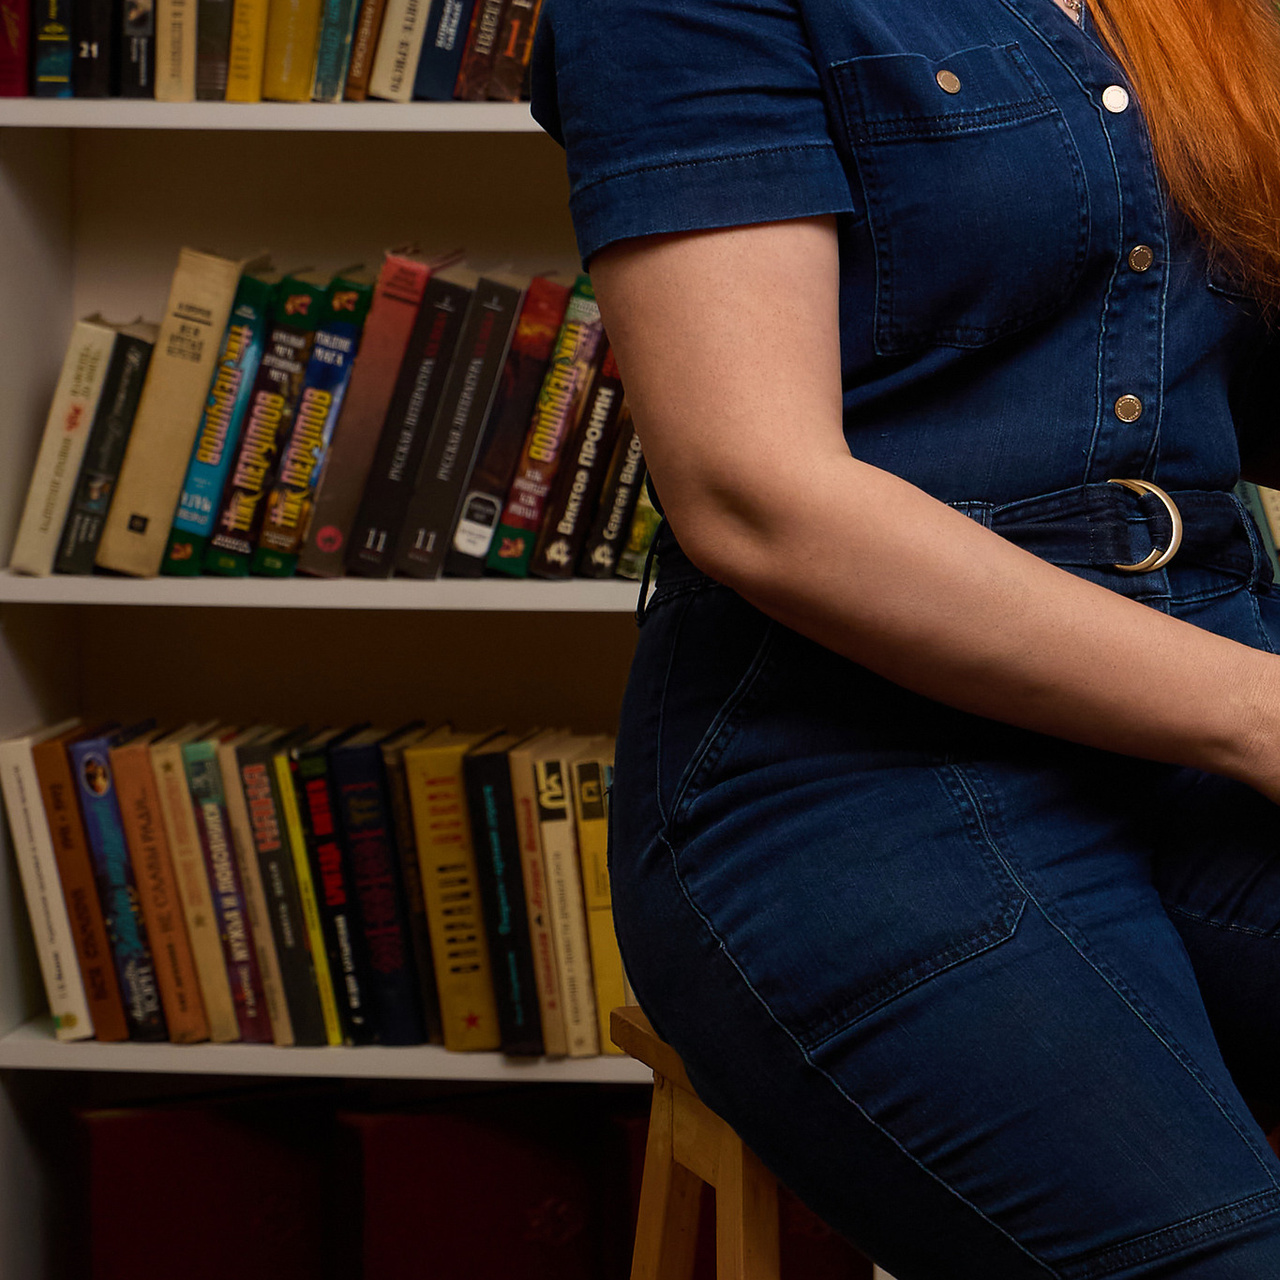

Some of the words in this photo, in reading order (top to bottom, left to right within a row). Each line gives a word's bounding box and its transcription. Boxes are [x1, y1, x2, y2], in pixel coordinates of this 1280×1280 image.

[232, 389, 286, 493] ПЕРУМОВ
[280, 386, 333, 489] ПЕРУМОВ
[387, 426, 417, 481] РУССКАЯ
[437, 426, 466, 481] РУССКАЯ
[577, 385, 616, 469] ПРОНИН
[617, 432, 644, 484] ВЫСО
[202, 803, 236, 893] ЛЮБОВНИКИ
[242, 763, 281, 853] НАНА
[222, 911, 252, 962] МУЖЬЯ
